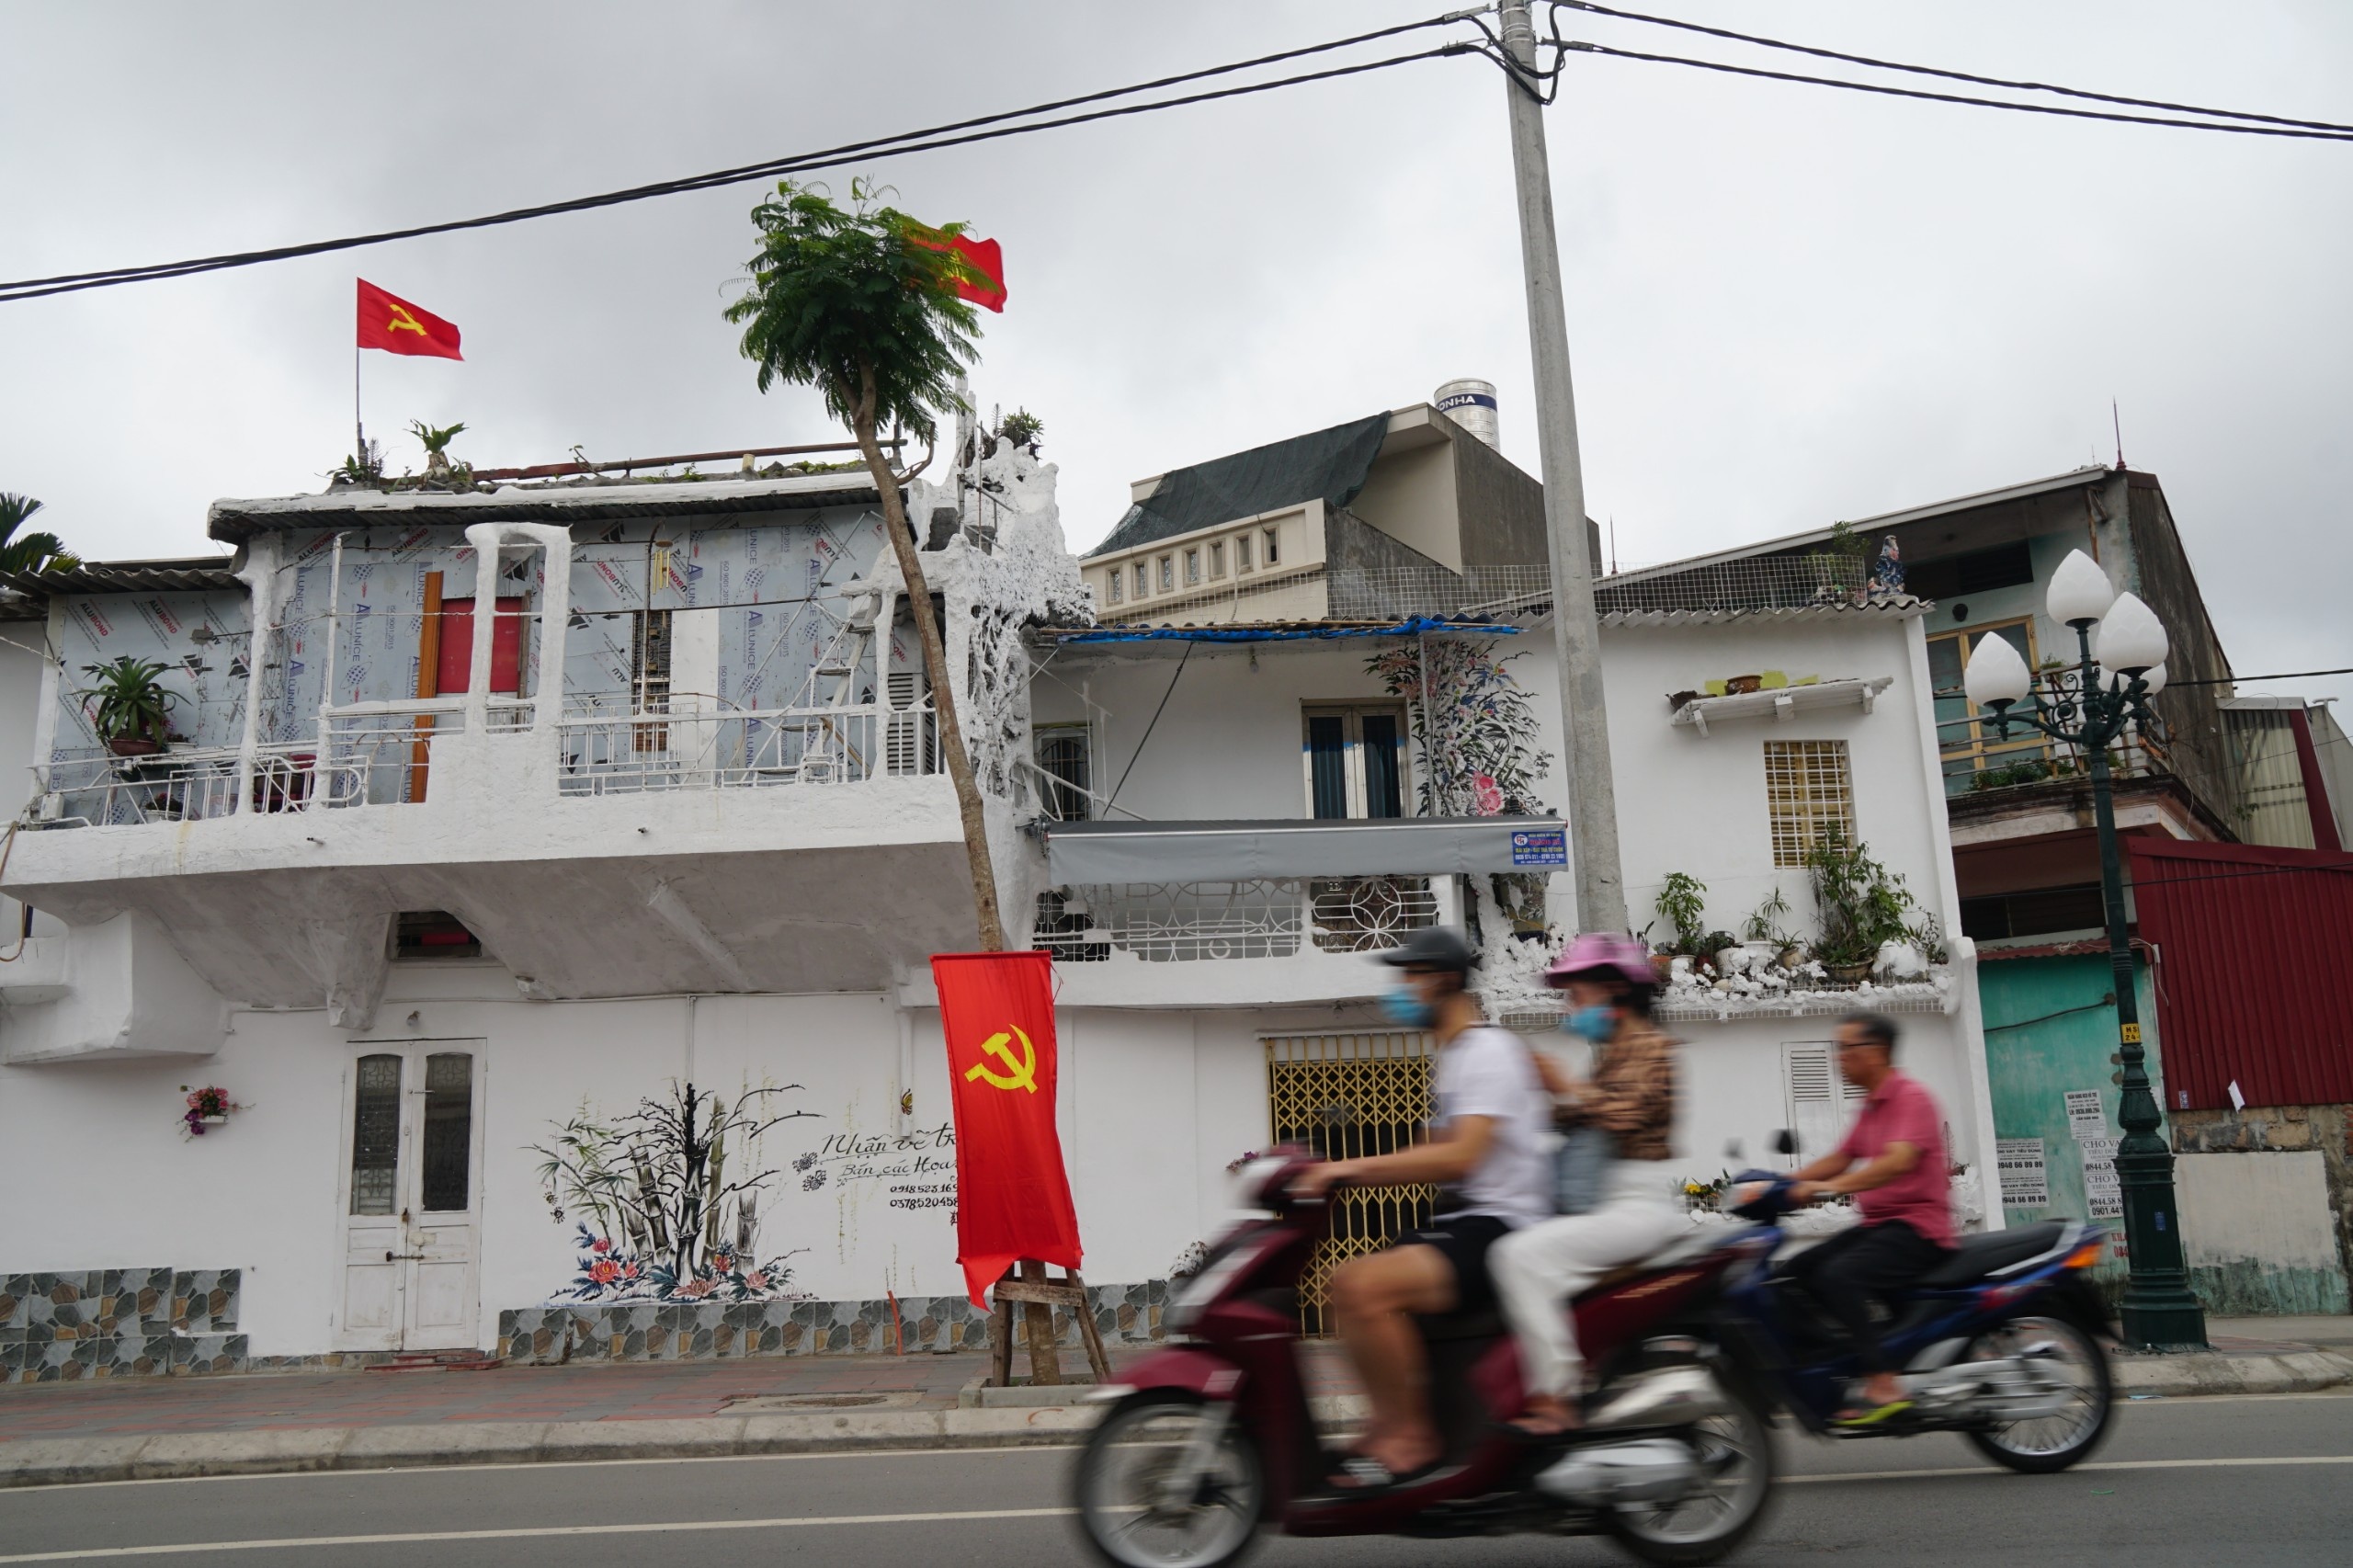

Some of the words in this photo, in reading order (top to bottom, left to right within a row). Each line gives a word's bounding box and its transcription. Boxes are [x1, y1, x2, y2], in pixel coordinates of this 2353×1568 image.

[298, 531, 336, 562] ALUBOND
[392, 528, 428, 557] ALUBOND
[749, 528, 758, 564] UNICE
[294, 574, 305, 614] LUNICE
[416, 570, 426, 610] LUNICE
[80, 602, 108, 637] ALUBOND
[148, 599, 177, 634] ALUBOND
[352, 603, 370, 662] ALUNICE
[747, 610, 764, 670] ALUNICE
[286, 660, 304, 720] ALUNICE
[2083, 1141, 2106, 1149] CHO
[841, 1162, 874, 1176] Bán
[882, 1159, 909, 1173] các
[2087, 1175, 2110, 1183] CHO
[2092, 1206, 2123, 1215] 0901.441
